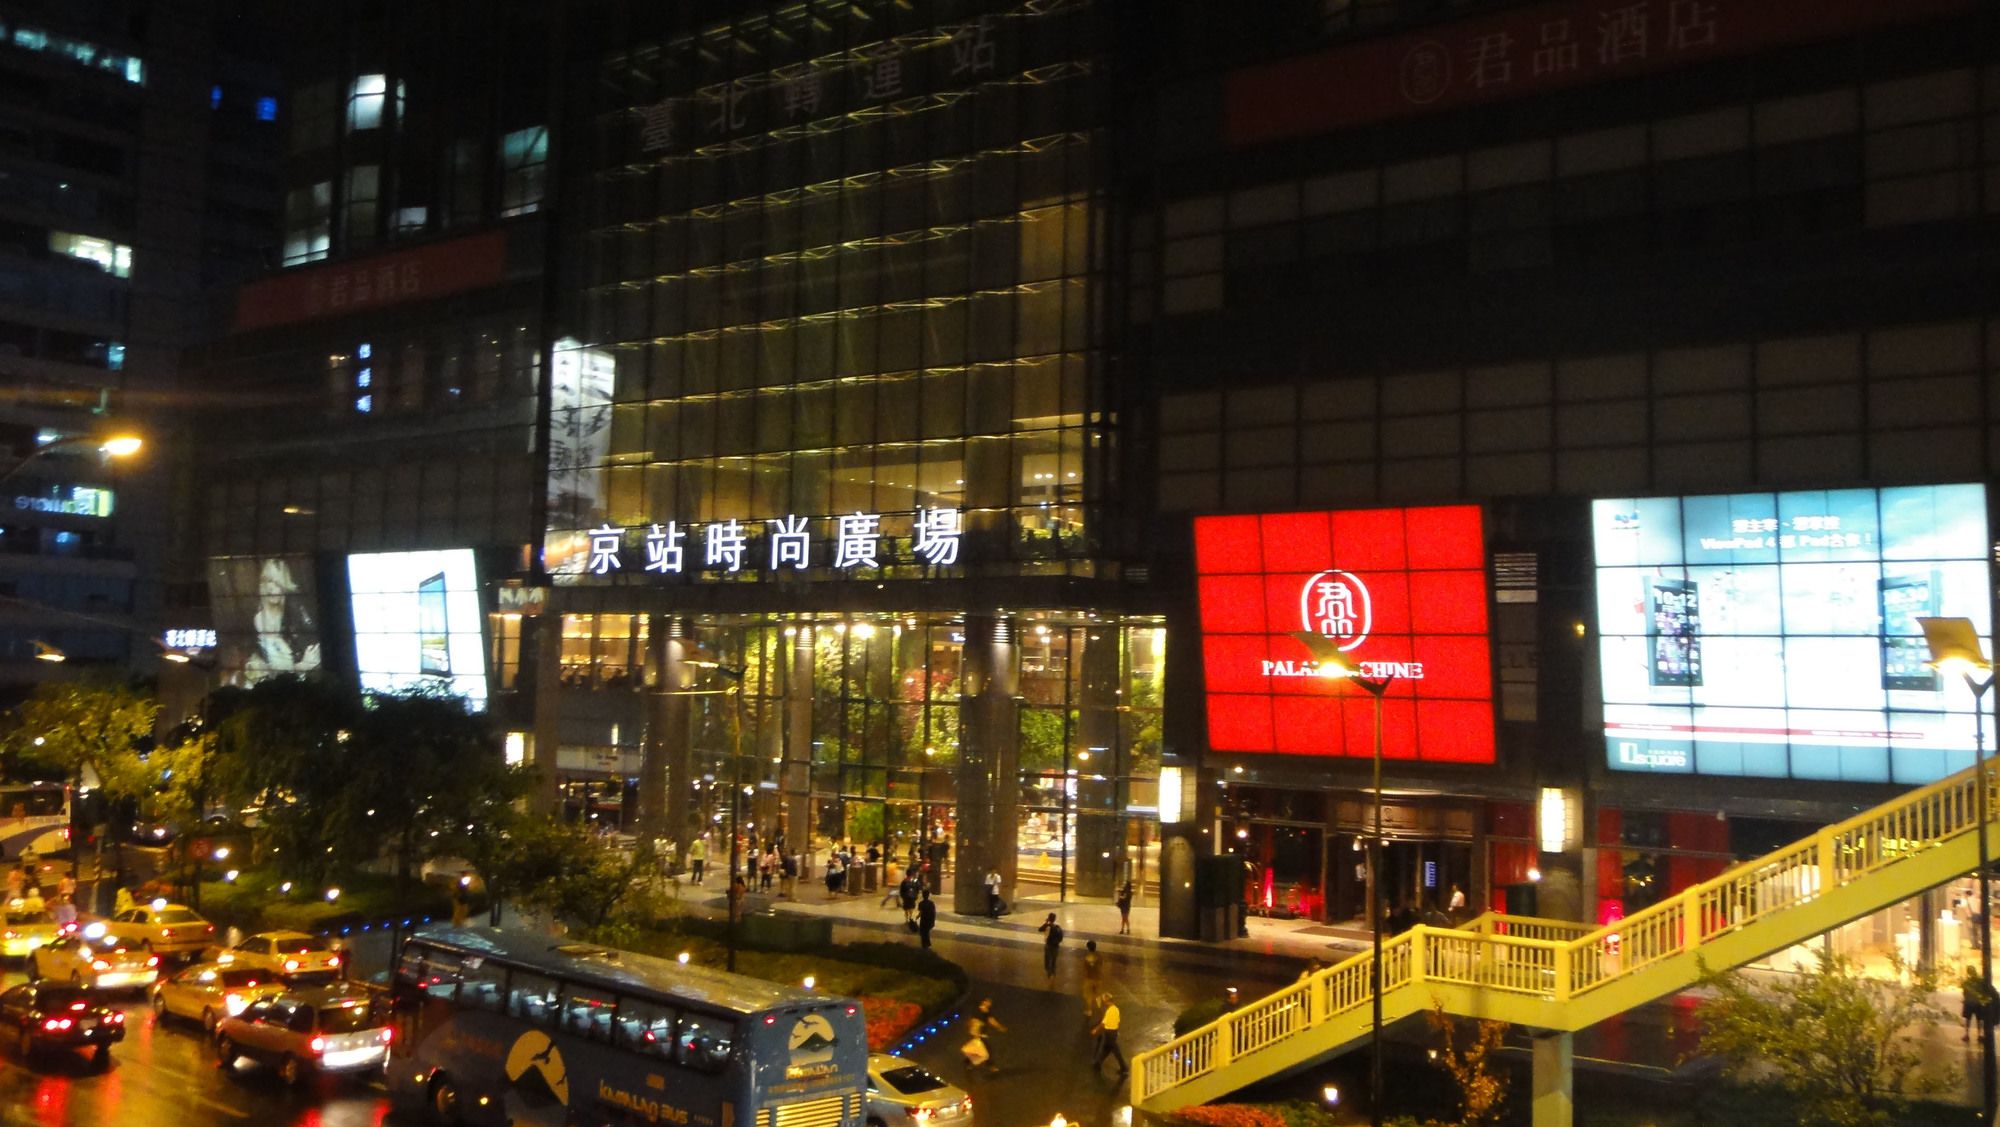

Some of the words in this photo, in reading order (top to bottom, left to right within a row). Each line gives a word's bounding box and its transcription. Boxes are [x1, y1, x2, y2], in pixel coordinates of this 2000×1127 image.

[1466, 0, 1718, 89] 君品酒店
[588, 508, 963, 575] 京站時尚廣場
